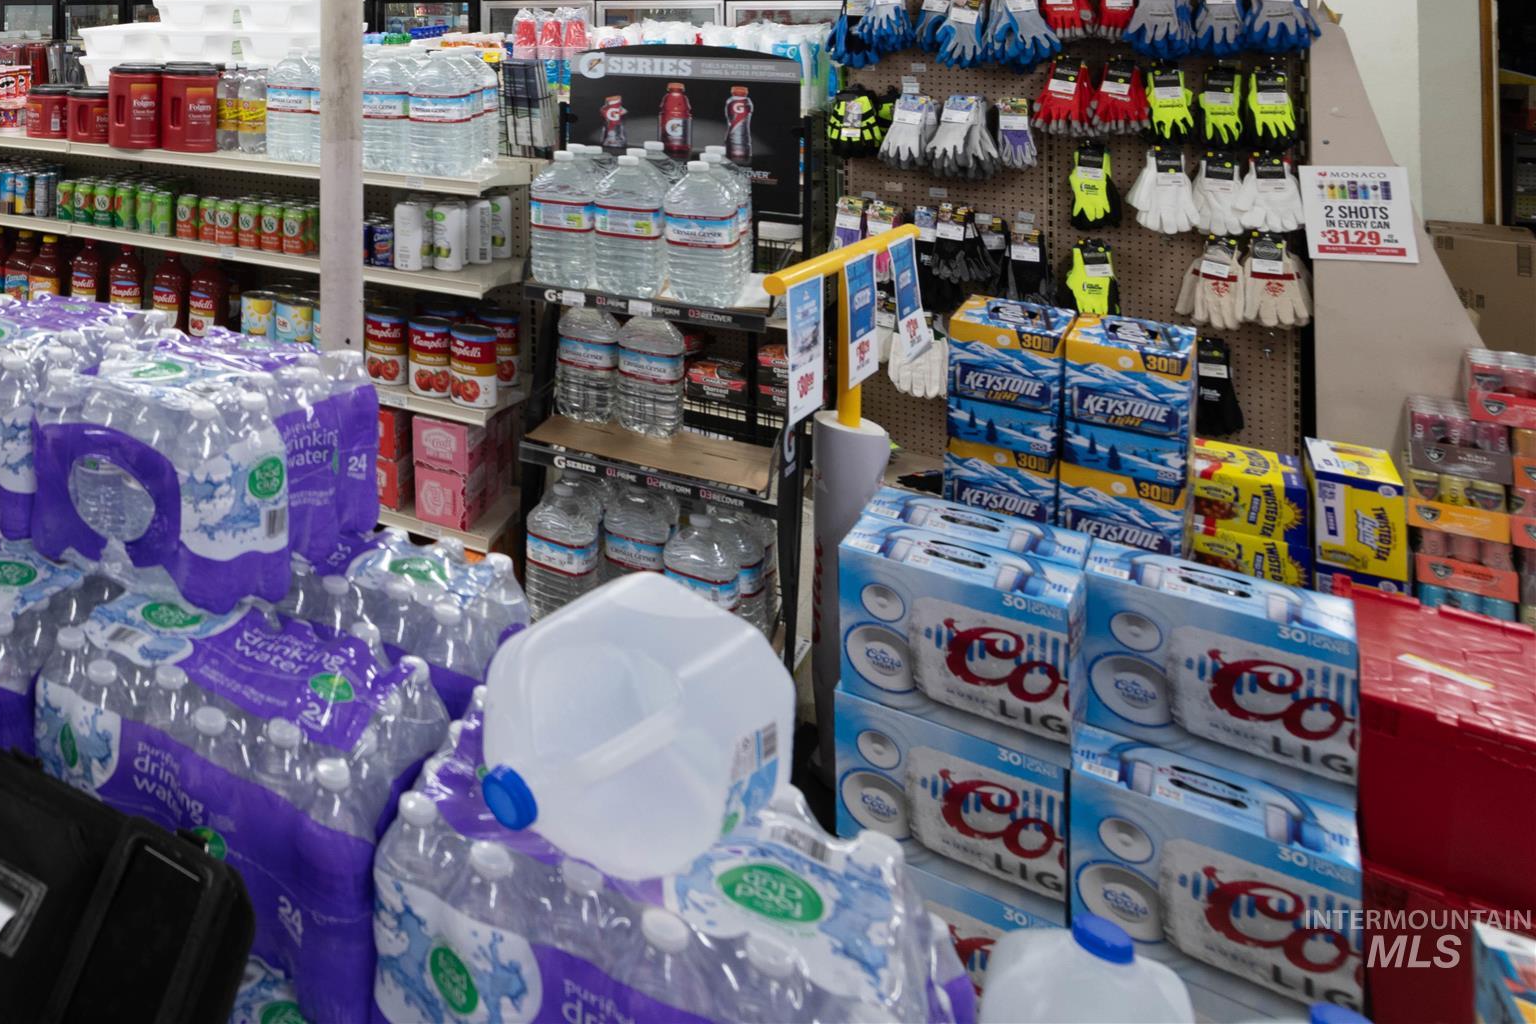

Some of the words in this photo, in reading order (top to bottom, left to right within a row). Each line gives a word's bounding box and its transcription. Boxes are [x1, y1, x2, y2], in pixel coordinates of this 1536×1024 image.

[608, 56, 693, 76] SERIES
[133, 98, 156, 108] Folgers
[189, 103, 212, 112] Folgers
[1330, 171, 1386, 179] MONACO
[1324, 205, 1334, 218] 2
[1338, 206, 1389, 219] SHOTS
[1326, 219, 1336, 227] IN
[1338, 220, 1367, 228] EVERY
[1370, 221, 1390, 229] CAN
[1321, 229, 1381, 245] $31.29
[111, 284, 141, 297] Campbell's
[366, 323, 400, 339] Campbell's
[1021, 333, 1041, 349] 30
[1146, 355, 1167, 372] 30
[965, 370, 1044, 398] KEYSTONE
[986, 390, 1019, 402] LIGHT
[1084, 394, 1170, 423] KEYSTONE
[1109, 415, 1143, 426] LIGHT
[346, 453, 368, 474] 24
[565, 459, 596, 474] SERIES
[1018, 454, 1037, 470] 30
[606, 466, 617, 477] 01
[646, 477, 658, 487] 02
[658, 481, 691, 495] PERFORM
[1139, 482, 1160, 498] 30
[700, 489, 712, 500] 03
[712, 492, 744, 507] RECOVER
[962, 487, 1040, 517] KEYSTONE
[1260, 484, 1278, 521] TWISTED
[1259, 521, 1275, 538] TEA
[1371, 506, 1390, 545] TWISTED
[1077, 518, 1163, 551] KEYSTONE
[1373, 545, 1392, 562] TEA
[1001, 593, 1025, 612] 30
[1278, 625, 1307, 643] 30
[234, 636, 302, 675] water
[242, 628, 345, 669] drinking
[998, 748, 1023, 766] 30
[1278, 846, 1308, 867] 30
[1004, 907, 1027, 926] 30
